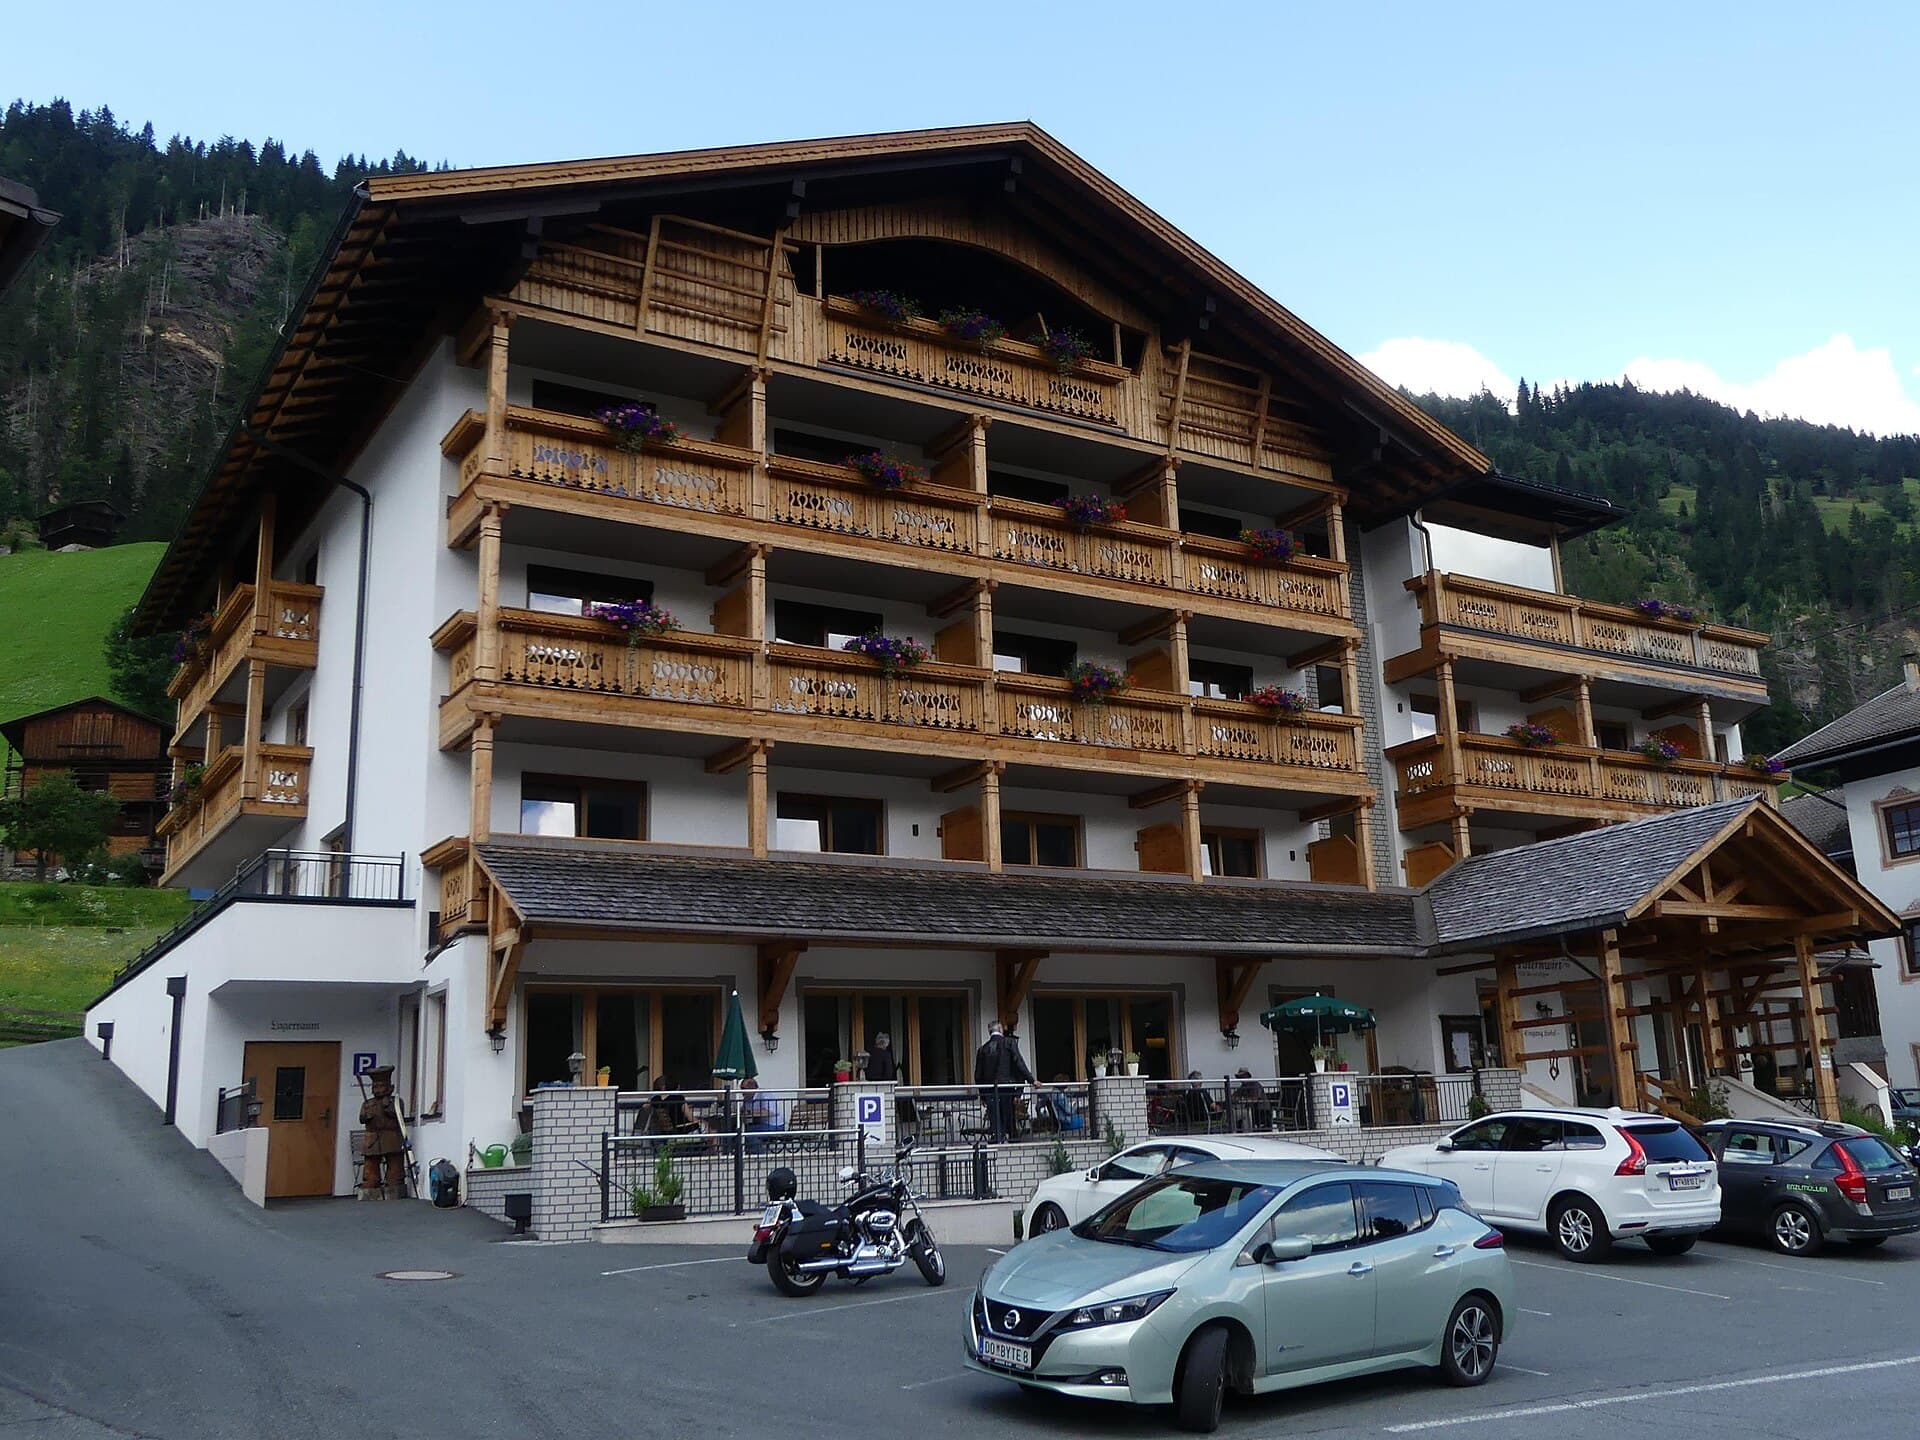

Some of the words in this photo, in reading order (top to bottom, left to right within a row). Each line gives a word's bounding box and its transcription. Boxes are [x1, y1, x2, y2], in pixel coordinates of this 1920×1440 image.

[359, 1056, 372, 1073] P
[1336, 1087, 1346, 1105] P
[864, 1099, 878, 1120] P
[1001, 1344, 1022, 1362] BYTE
[1023, 1350, 1029, 1363] 8
